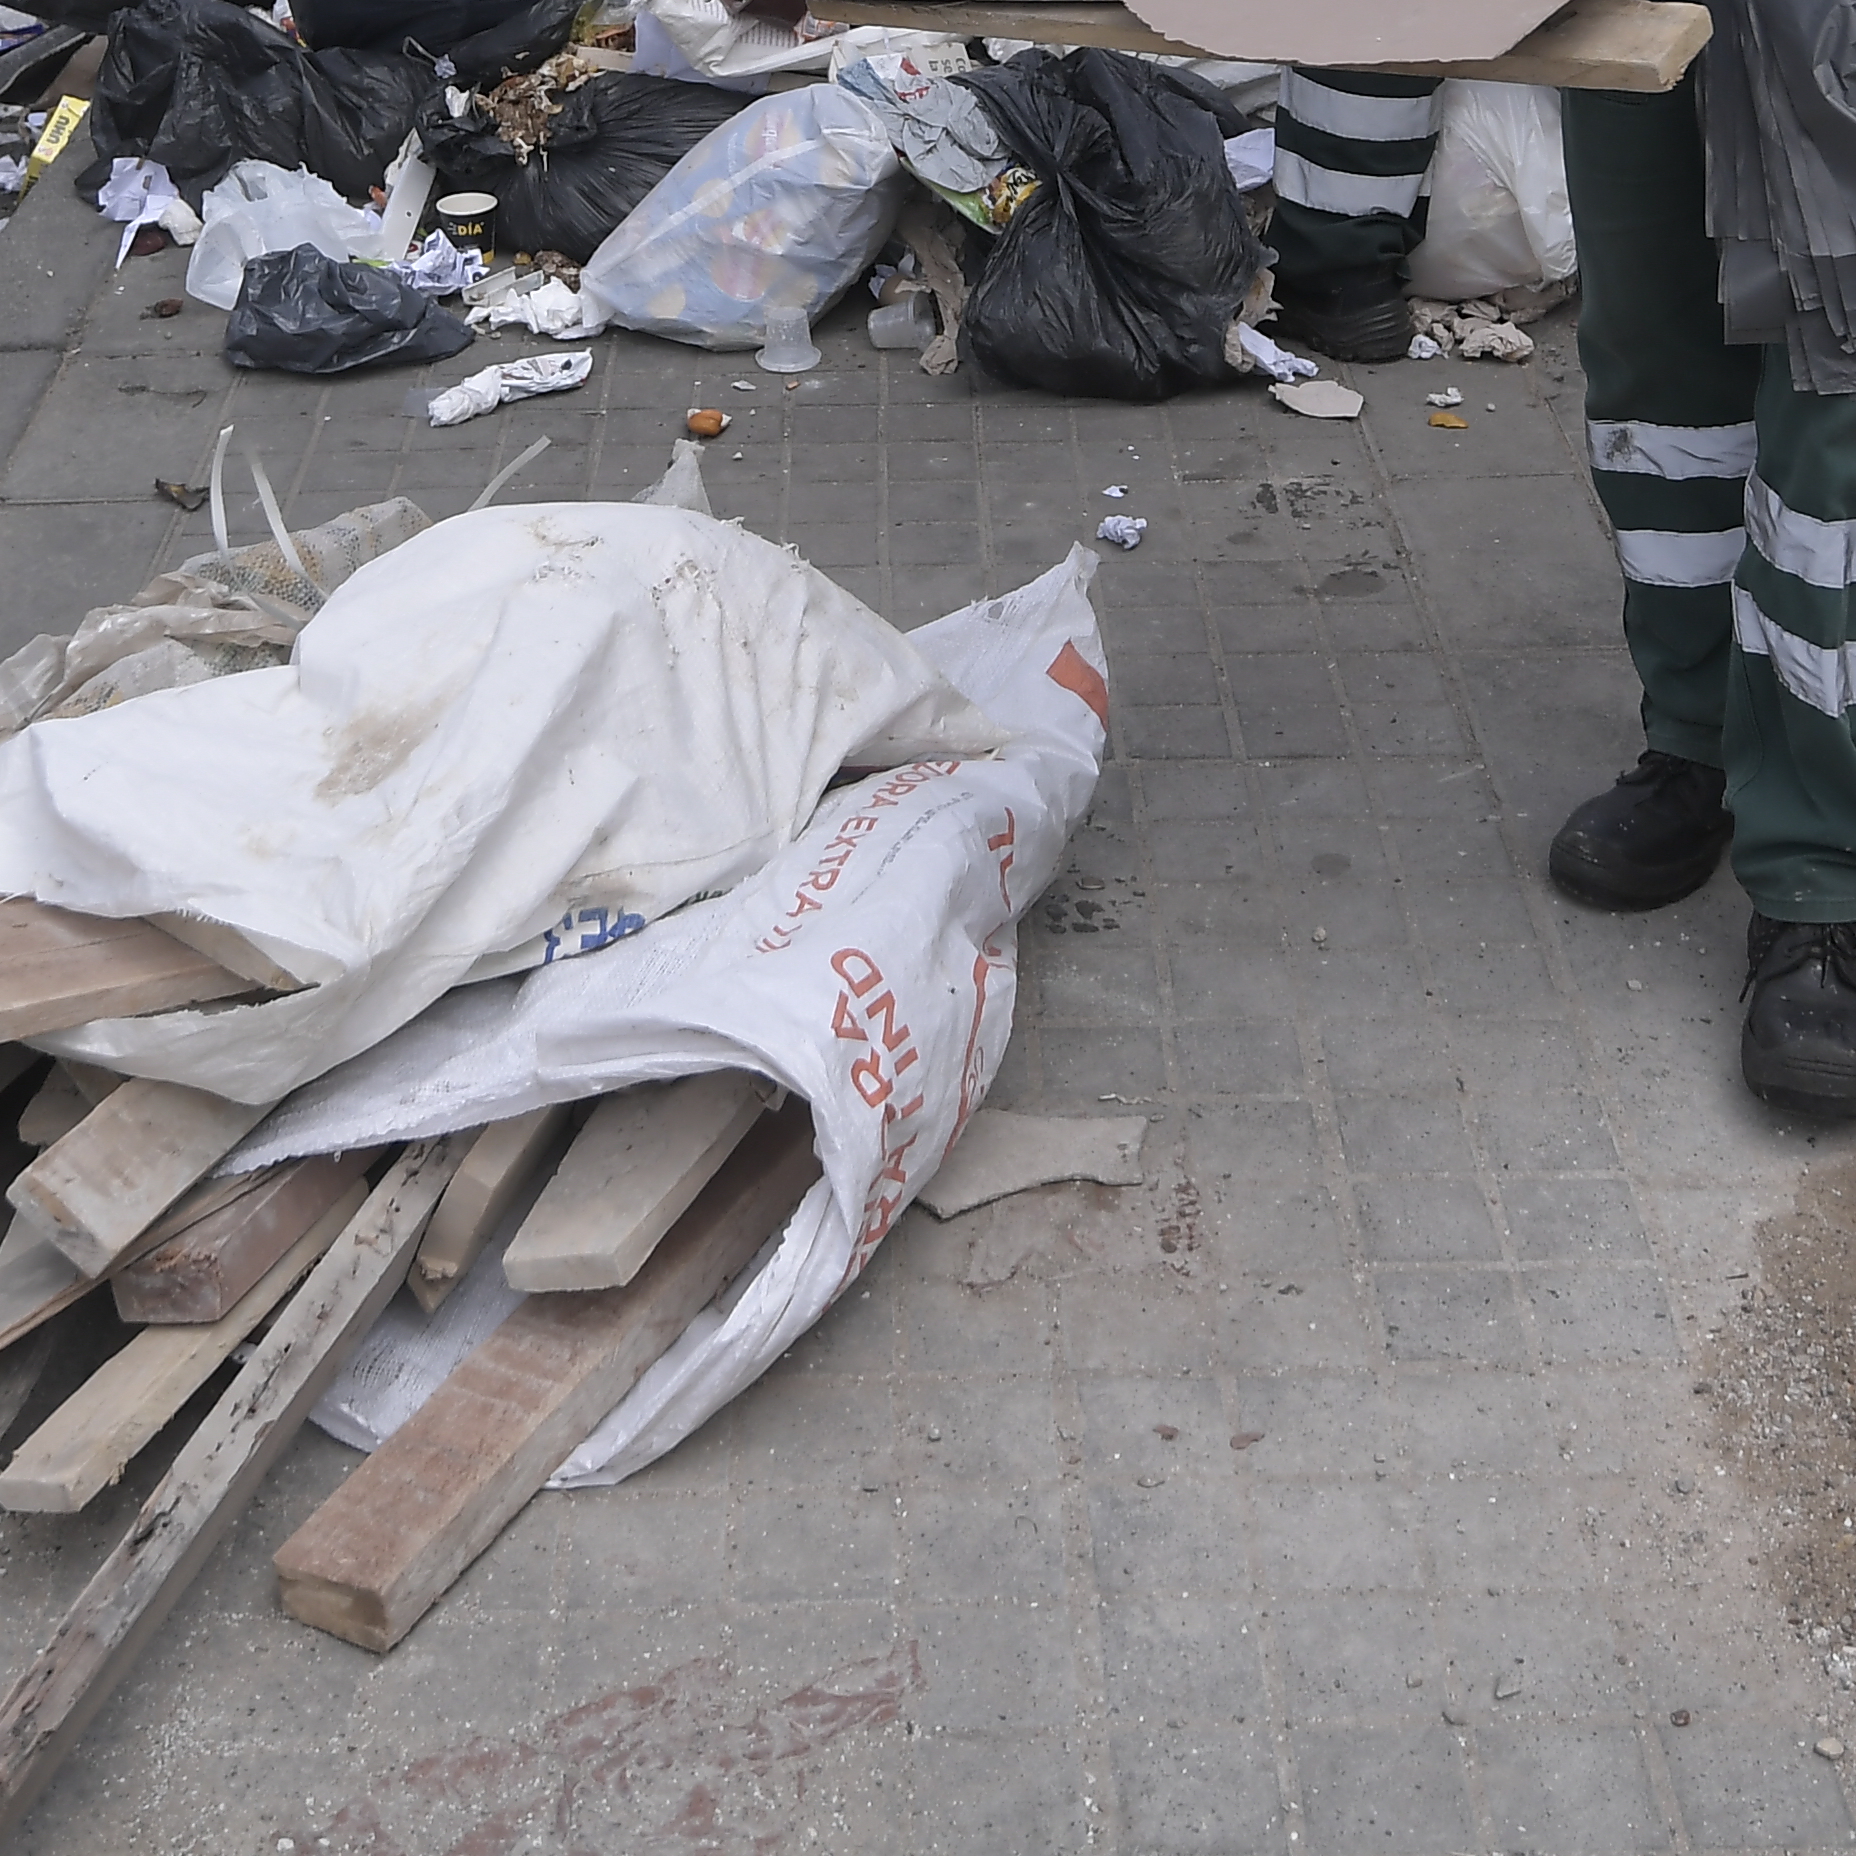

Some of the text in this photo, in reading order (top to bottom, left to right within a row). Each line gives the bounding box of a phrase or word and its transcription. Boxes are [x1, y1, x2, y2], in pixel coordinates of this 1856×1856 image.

[45, 114, 71, 145] UHU
[457, 222, 483, 237] DÍA
[792, 814, 878, 920] EXTRA
